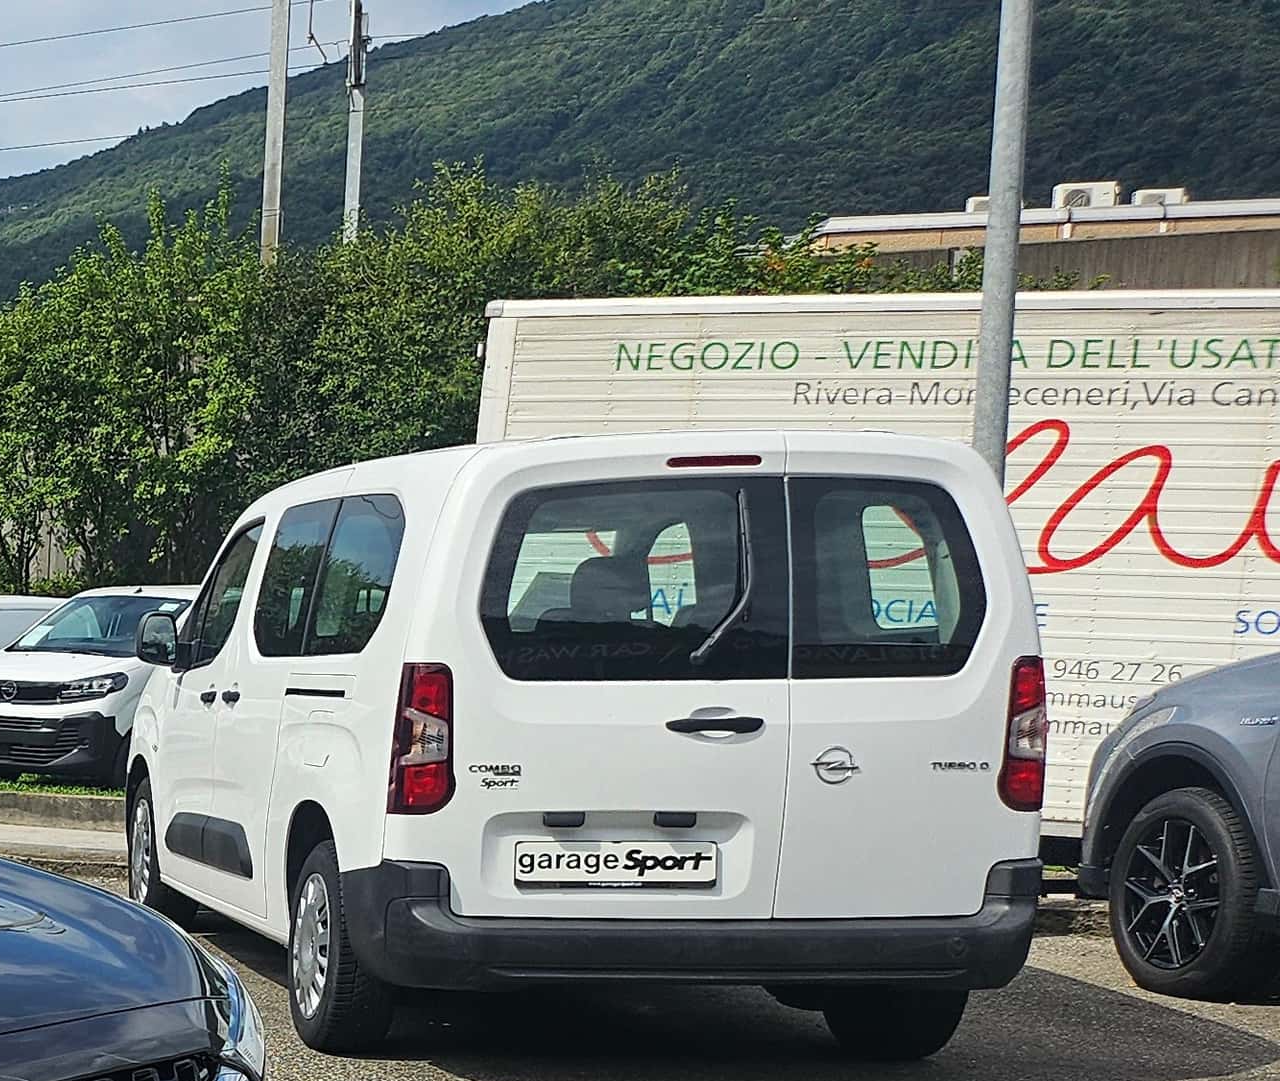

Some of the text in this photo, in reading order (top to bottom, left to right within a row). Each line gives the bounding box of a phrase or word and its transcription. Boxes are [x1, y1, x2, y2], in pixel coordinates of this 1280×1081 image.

[615, 340, 801, 372] NEGOZIO
[842, 339, 1028, 371] VENDIA
[1052, 659, 1184, 683] 946 27 26
[479, 777, 520, 790] Sport
